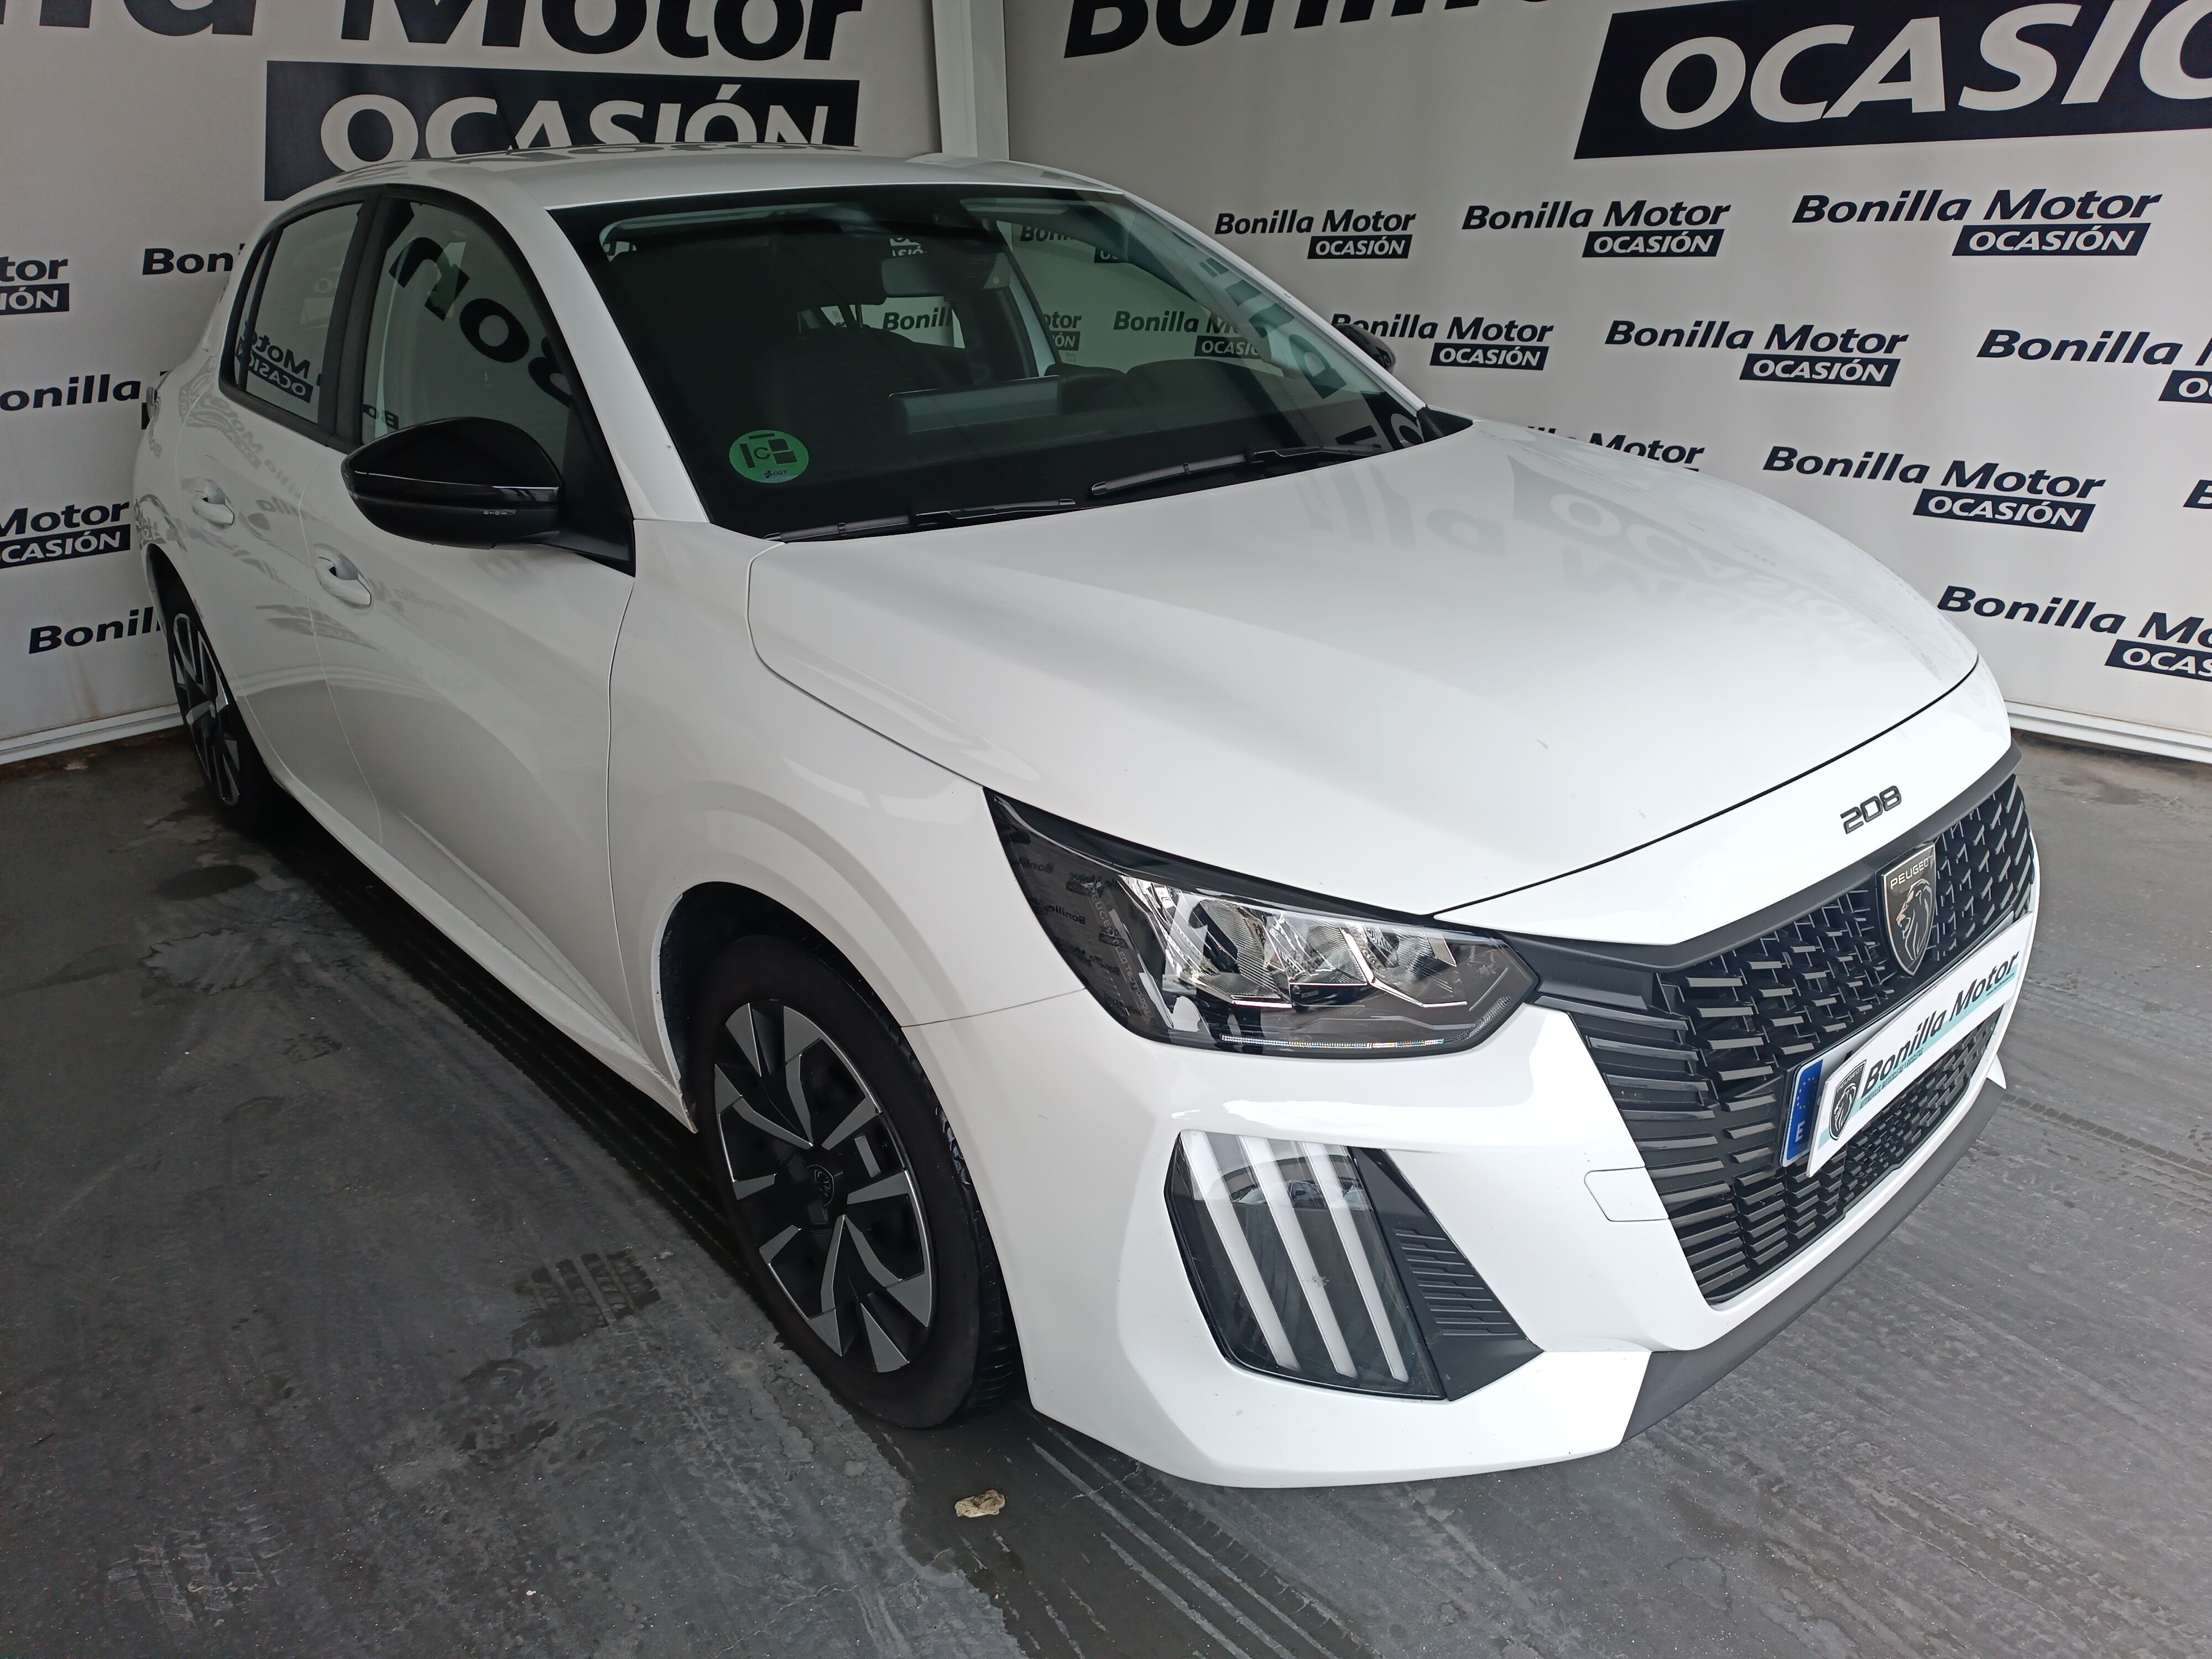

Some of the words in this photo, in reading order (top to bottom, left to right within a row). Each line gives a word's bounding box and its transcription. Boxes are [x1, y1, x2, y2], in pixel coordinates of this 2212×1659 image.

[1462, 201, 1594, 229] Bonilla
[1603, 200, 1731, 227] Motor
[1792, 189, 1972, 223] Bonilla
[1984, 189, 2162, 220] Motor
[1215, 210, 1314, 234] Bonilla
[1322, 210, 1416, 232] Motor
[1315, 237, 1405, 256] OCASIÓN
[1594, 231, 1713, 253] OCASIÓN
[1969, 225, 2135, 252] OCASIÓN
[1113, 310, 1199, 333] Bonilla
[1446, 317, 1554, 342] Motor
[1604, 320, 1754, 349] Bonilla
[1764, 324, 1909, 354] Motor
[1976, 329, 2183, 364] Bonilla
[1439, 347, 1541, 366] OCASIÓN
[1752, 359, 1888, 382] OCASIÓN
[754, 447, 770, 460] C
[1762, 446, 1930, 484] Bonilla
[1940, 460, 2106, 498] Motor
[1928, 502, 2080, 526] OCASIÓN
[0, 531, 120, 563] CASIÓN
[1937, 585, 2126, 634] Bonilla
[1840, 785, 1902, 834] 208
[1890, 855, 1933, 890] PEUGEOT
[1860, 1010, 1947, 1099] Bonilla
[1949, 951, 2019, 1021] Motor
[1795, 1120, 1806, 1142] E
